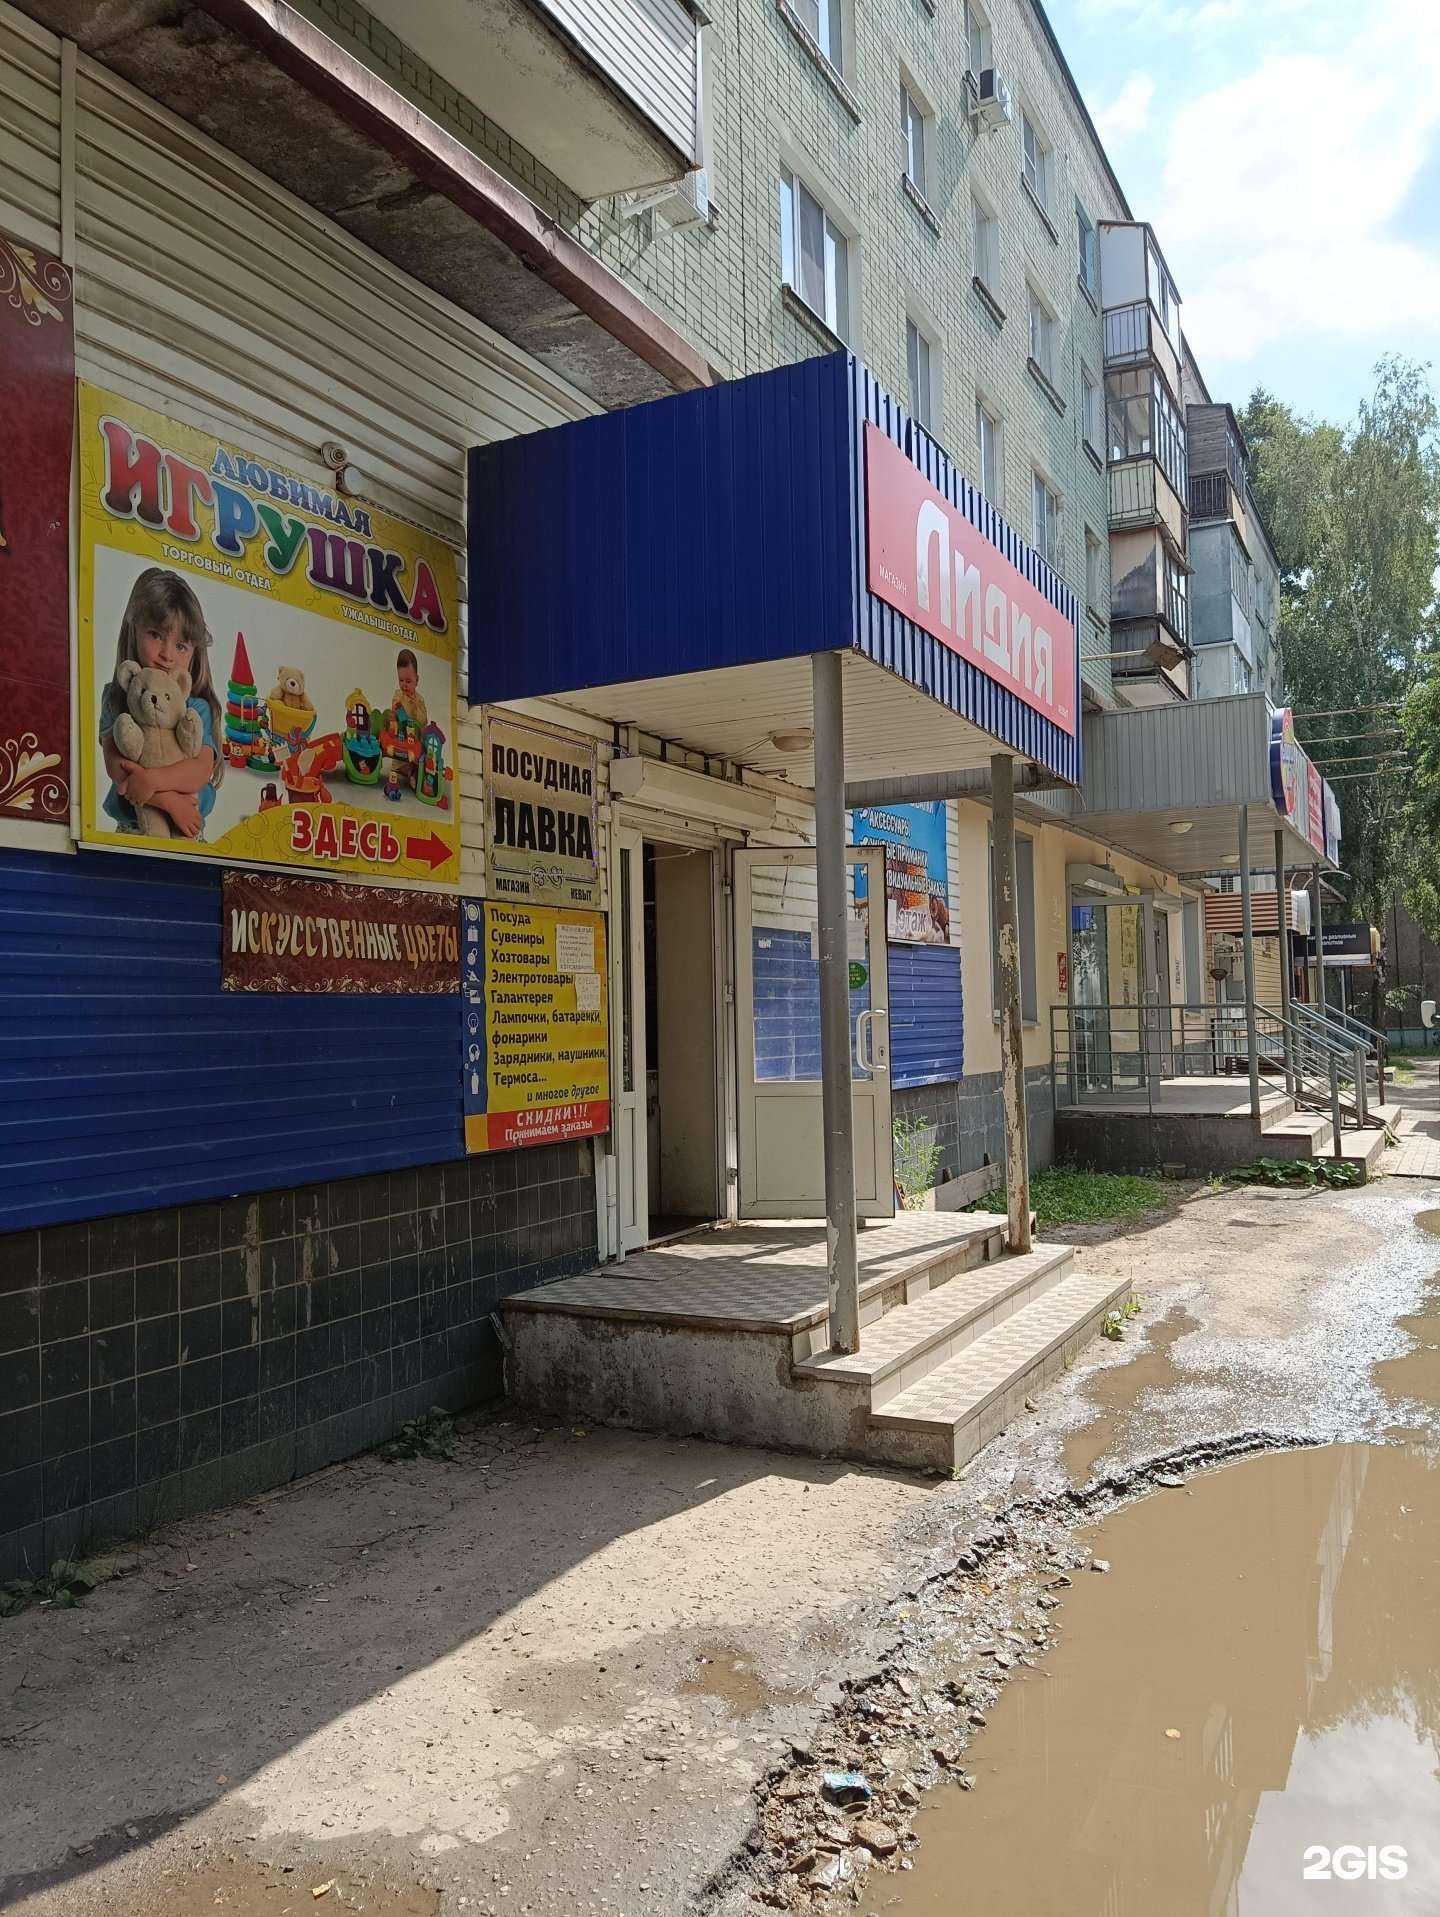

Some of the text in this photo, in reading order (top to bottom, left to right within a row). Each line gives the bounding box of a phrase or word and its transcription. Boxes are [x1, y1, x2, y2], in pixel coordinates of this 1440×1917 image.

[210, 447, 373, 539] ЛЮБИМАЯ
[99, 414, 448, 634] ИГРУШКА
[161, 543, 272, 591] ТОРГОВЫЙ ОТДЕЛ
[879, 563, 908, 597] МАГАЗИН
[392, 624, 419, 642] ОТДЕЛ
[492, 743, 592, 797] ПОСУДНАЯ
[291, 809, 400, 863] ЗДЕСЬ
[494, 796, 594, 861] ЛАВКА
[495, 877, 530, 894] МАГАЗИН
[490, 908, 532, 927] Посуда
[231, 908, 459, 969] ИСКУССТВЕННЫЕ ЦВЕТЫ
[491, 928, 545, 947] Сувениры
[491, 949, 550, 967] Хозтовары
[491, 969, 574, 987] Электротовары
[490, 990, 554, 1007] Галантерея
[492, 1010, 549, 1025] Лампочки,
[491, 1031, 548, 1048] фонарики
[493, 1051, 555, 1068] Зарядники,
[493, 1071, 547, 1088] Термоса...
[527, 1084, 600, 1102] и многое другое
[516, 1104, 588, 1127] СКИДКИ!!!
[505, 1120, 593, 1143] Принимаем заказы
